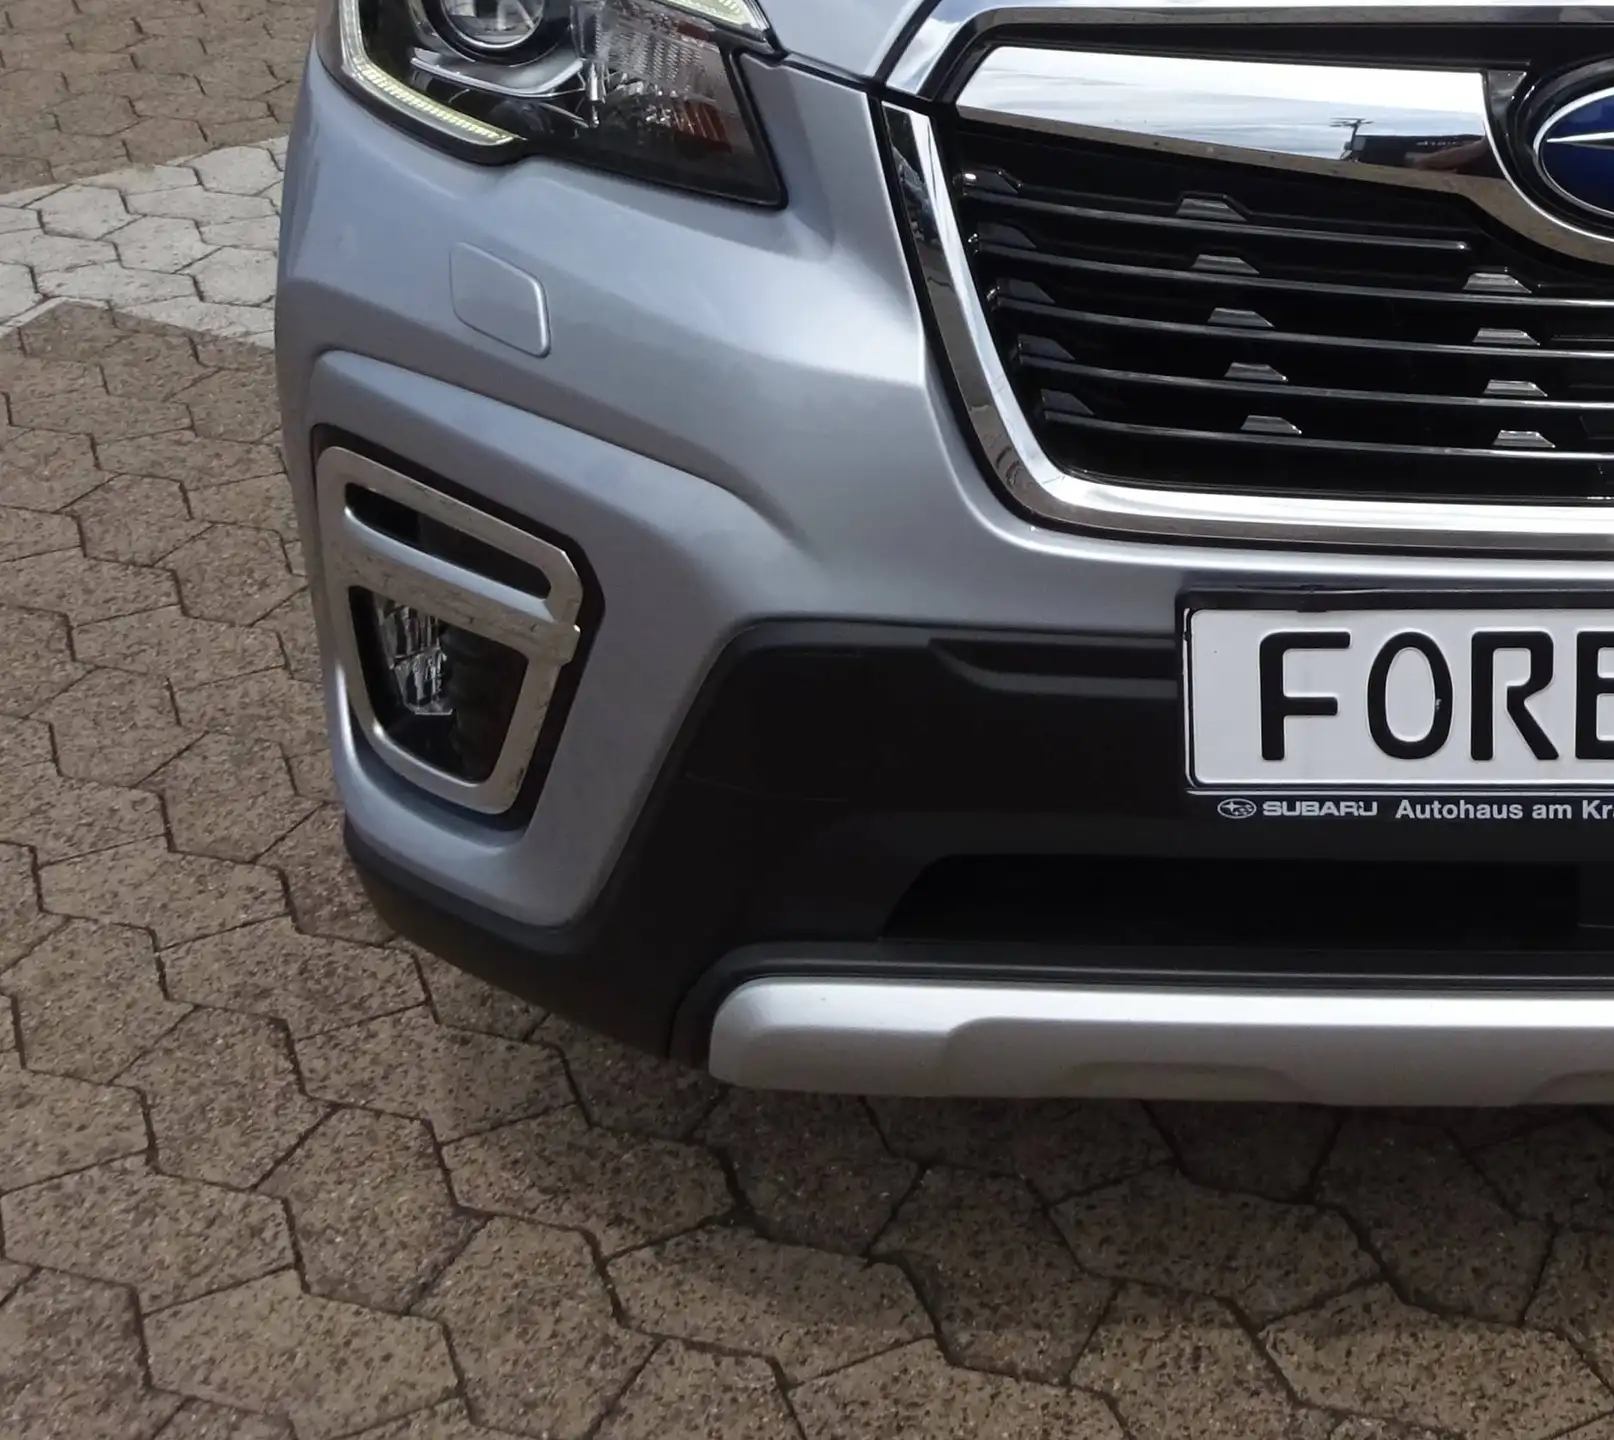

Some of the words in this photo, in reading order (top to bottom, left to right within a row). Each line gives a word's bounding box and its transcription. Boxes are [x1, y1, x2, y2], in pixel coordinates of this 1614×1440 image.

[1262, 800, 1377, 818] SUBARU
[1395, 799, 1523, 820] Autohaus
[1531, 804, 1572, 820] am
